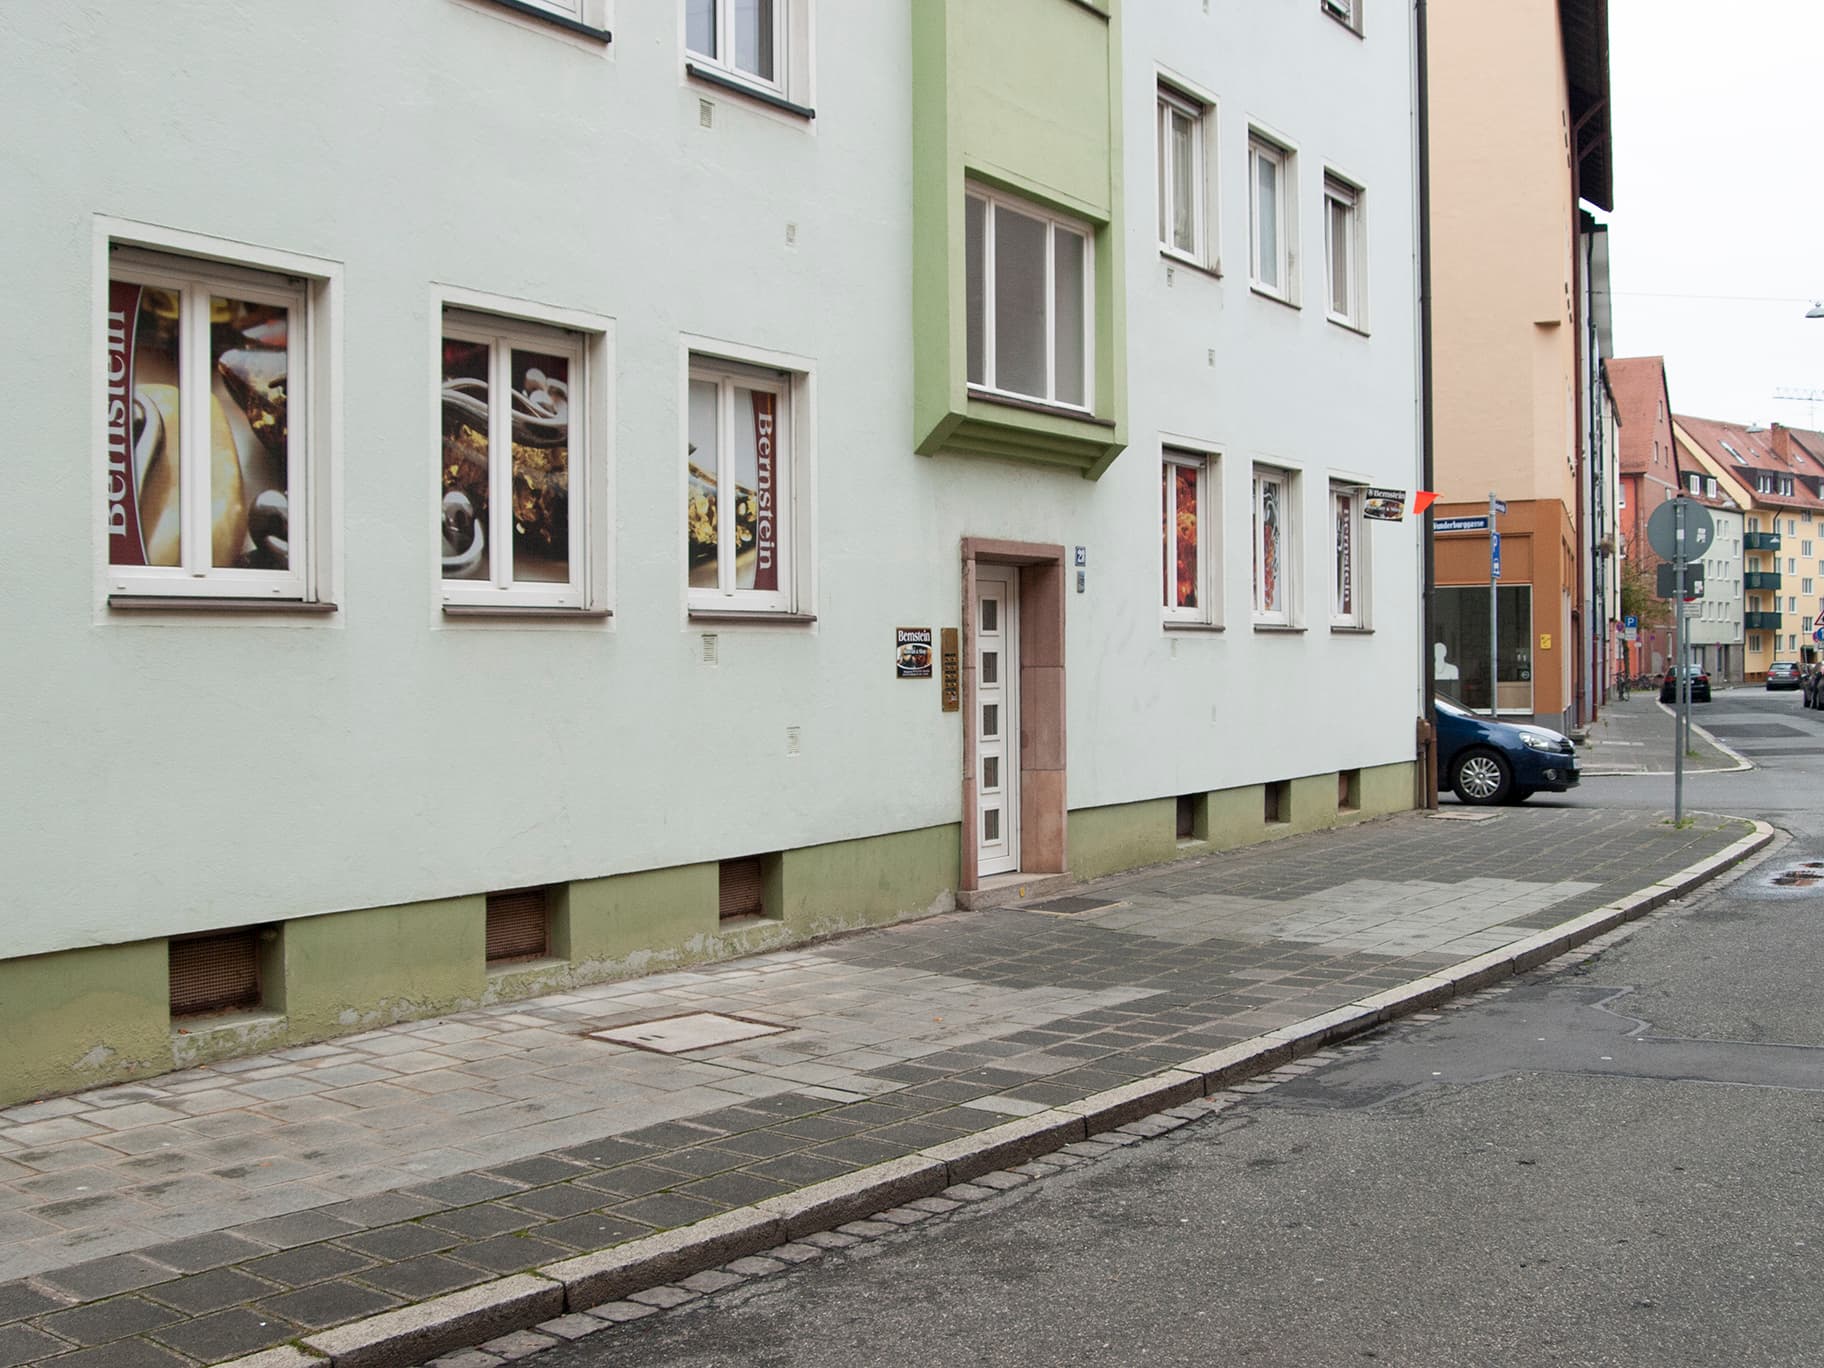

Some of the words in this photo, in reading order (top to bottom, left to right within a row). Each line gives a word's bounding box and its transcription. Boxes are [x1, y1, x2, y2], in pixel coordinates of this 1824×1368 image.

[758, 413, 775, 569] Bernstein
[1374, 490, 1406, 500] Bernstein
[898, 629, 931, 642] Bernstein
